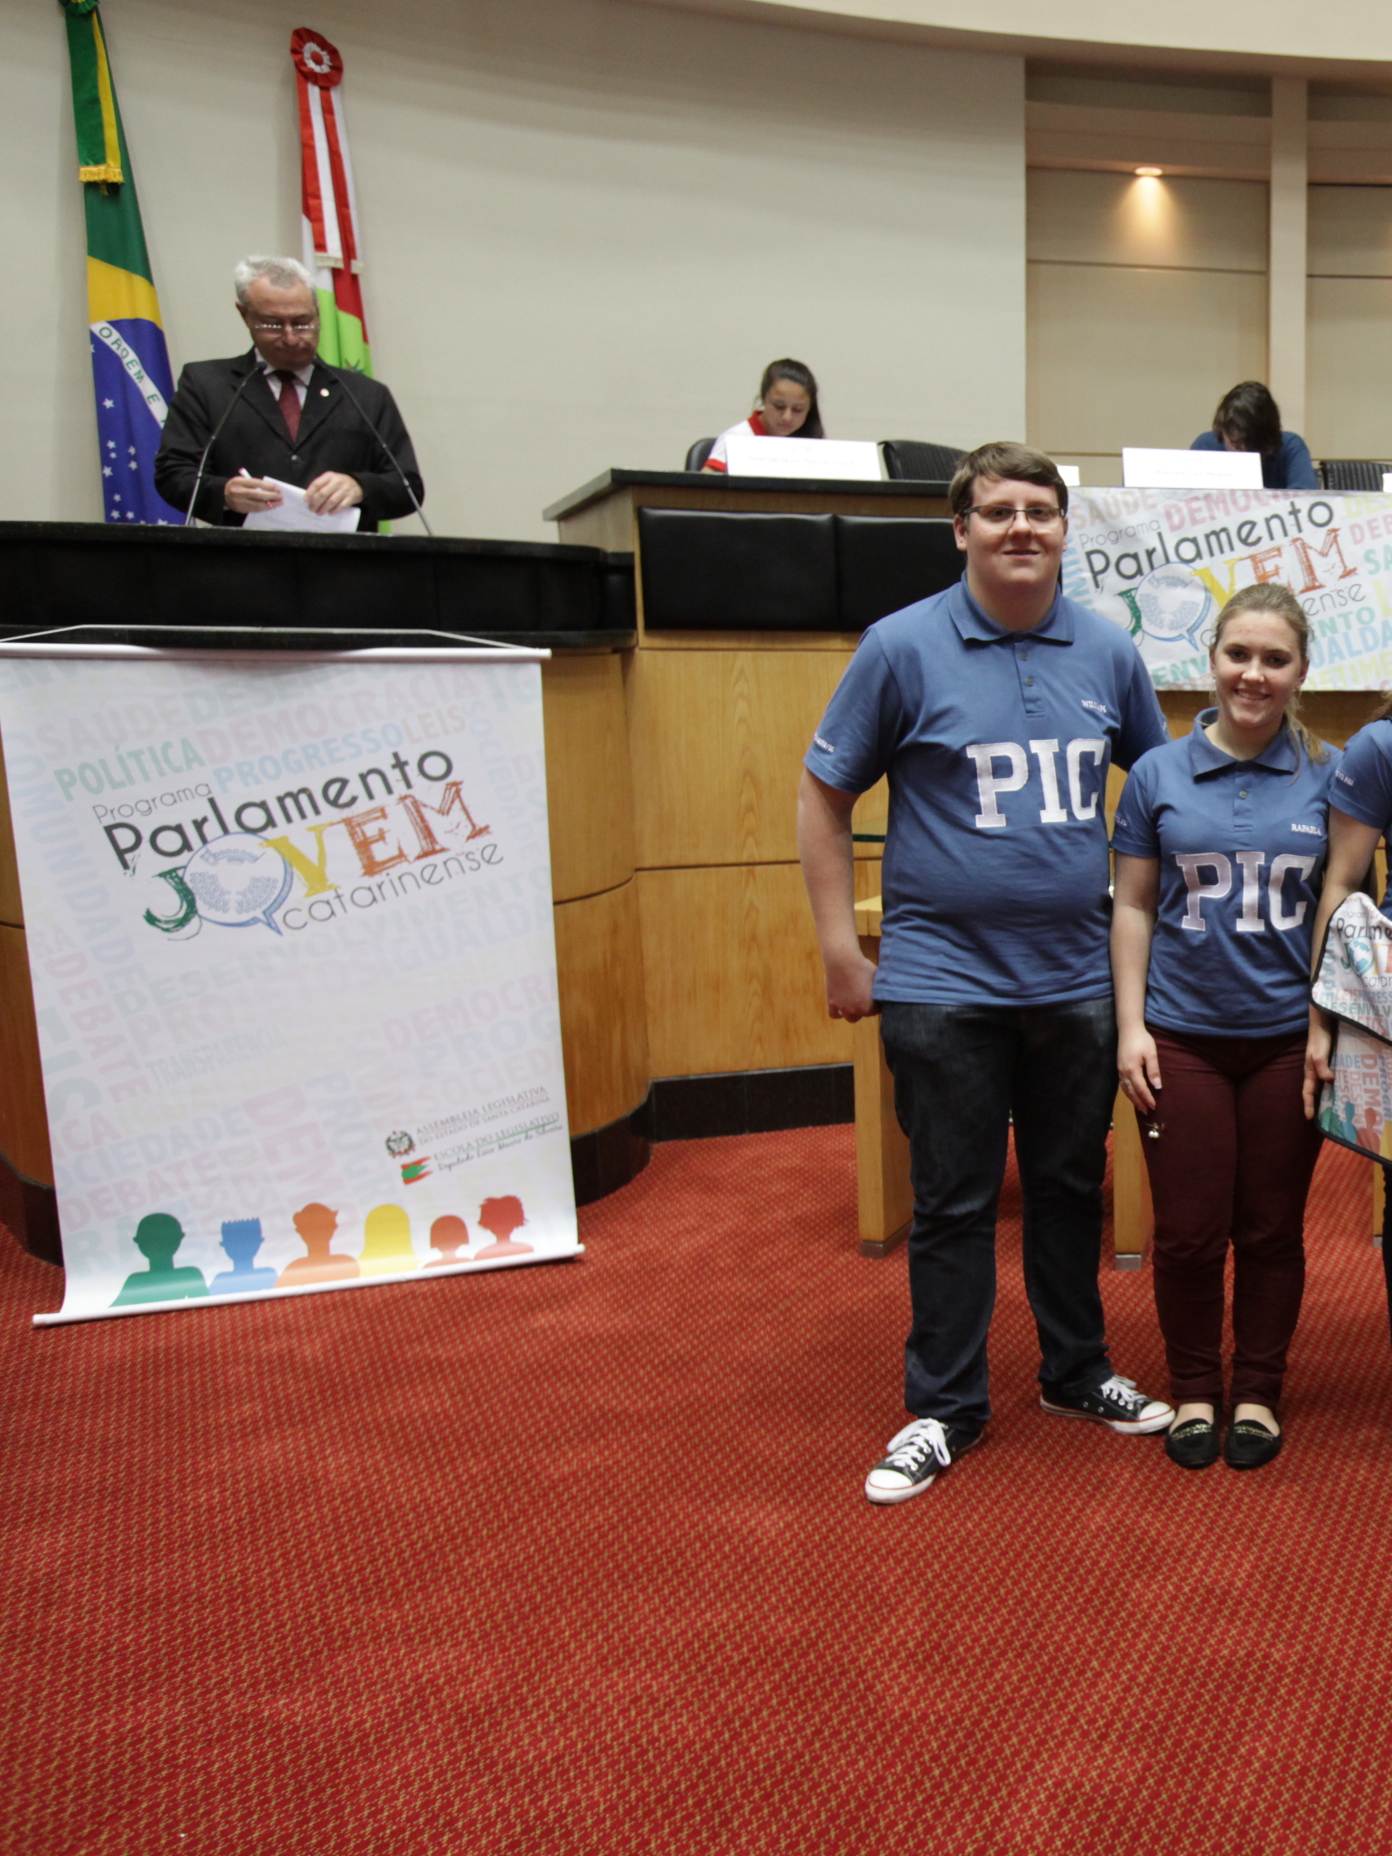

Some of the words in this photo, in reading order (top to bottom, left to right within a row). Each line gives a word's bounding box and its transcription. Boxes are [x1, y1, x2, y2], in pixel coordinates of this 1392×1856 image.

[99, 326, 144, 384] ORDEM
[146, 393, 161, 405] E
[1079, 519, 1160, 550] Programa
[1084, 500, 1335, 589] Parlamento
[196, 664, 480, 765] DEMOCRACIA
[402, 705, 467, 745] LEIS
[53, 737, 206, 801] POLÍTICA
[212, 723, 404, 794] PROGRESSO
[966, 738, 1105, 827] PIC
[92, 782, 213, 824] Programa
[102, 750, 453, 871] Parlamento
[3, 731, 148, 992] COMUNIDADE
[142, 780, 492, 942] JOVEM
[282, 843, 504, 931] catarinense
[1175, 850, 1318, 932] PIC
[44, 950, 151, 1103] DEBATE
[416, 1108, 481, 1136] ASSEMBLEIA
[481, 1085, 548, 1113] LEGISLATIVA
[434, 1141, 474, 1161] ESCOLA
[495, 1111, 560, 1139] LEGISLATIVO
[435, 1124, 467, 1141] ESTADO
[510, 1096, 551, 1114] CATARINA
[60, 1151, 222, 1232] DEBATE
